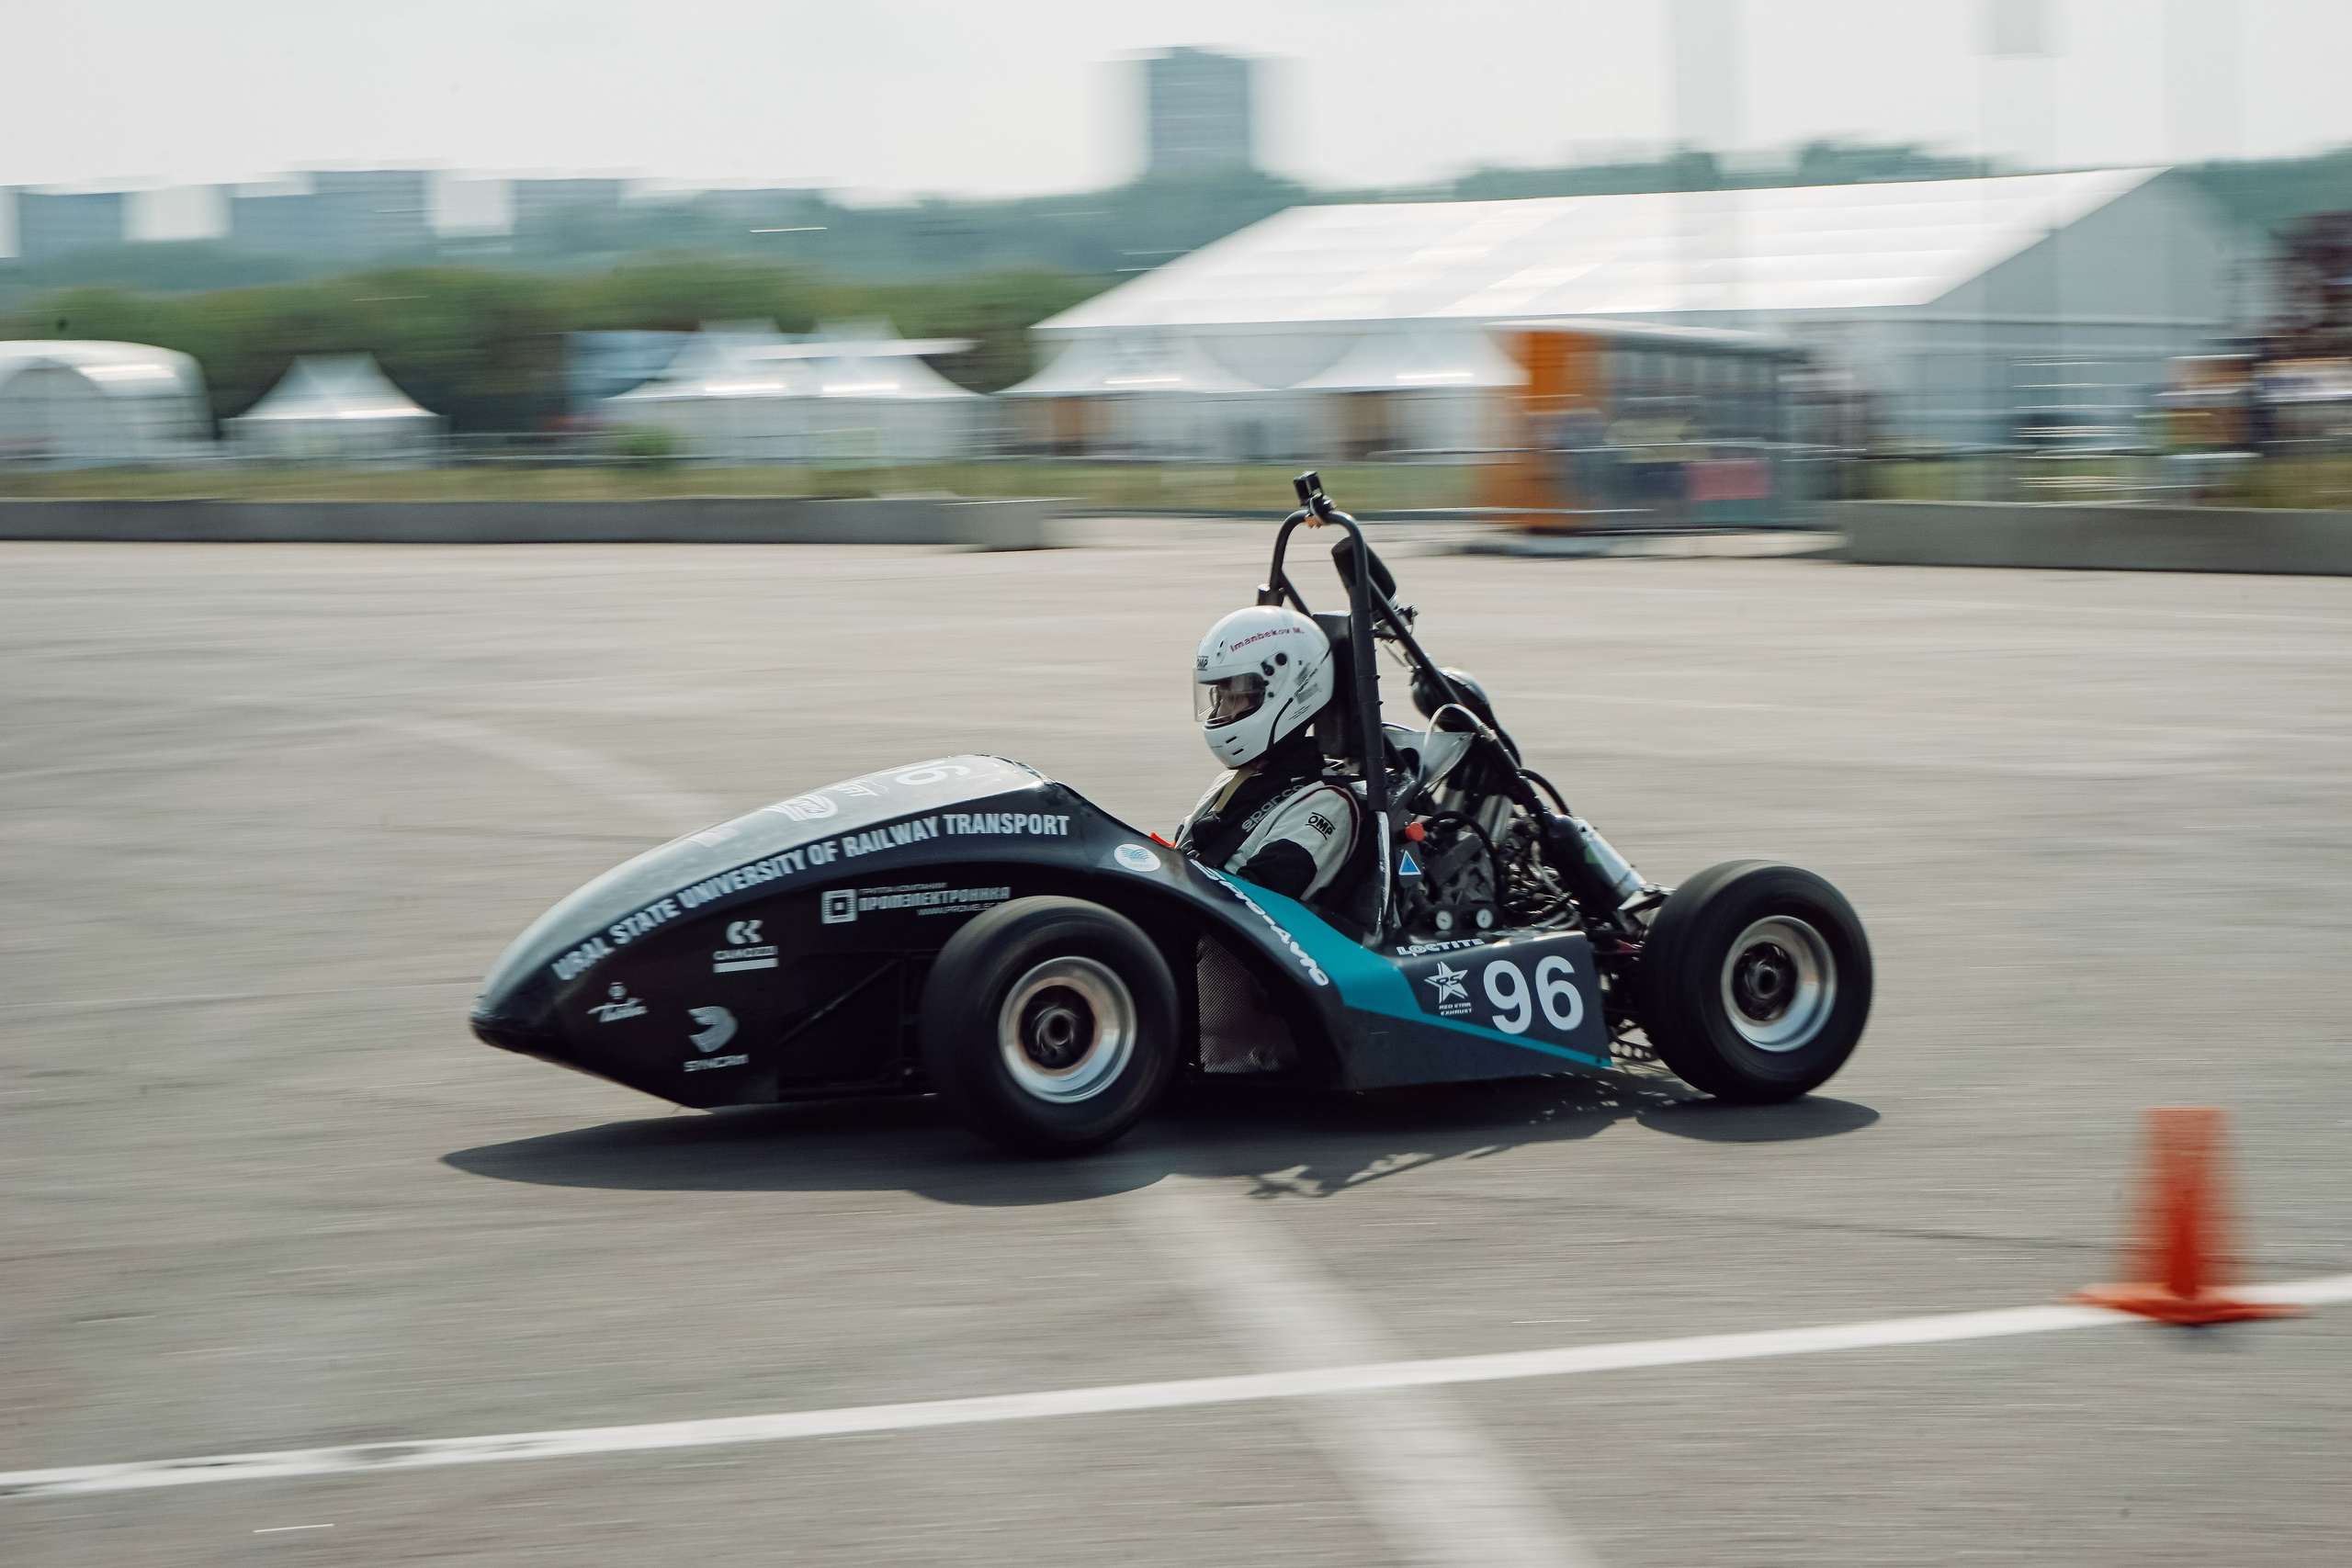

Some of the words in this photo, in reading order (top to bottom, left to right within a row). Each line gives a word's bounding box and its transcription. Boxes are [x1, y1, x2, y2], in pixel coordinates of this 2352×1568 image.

[1307, 816, 1334, 836] OMP
[552, 937, 615, 980] URAL
[609, 898, 682, 944] STATE
[678, 850, 807, 908] UNIVERSITY
[807, 840, 839, 866] OF
[842, 817, 939, 857] RAILWAY
[942, 812, 1070, 836] TRANSPORT
[1396, 938, 1485, 956] LOCTITE
[1483, 955, 1584, 1034] 96
